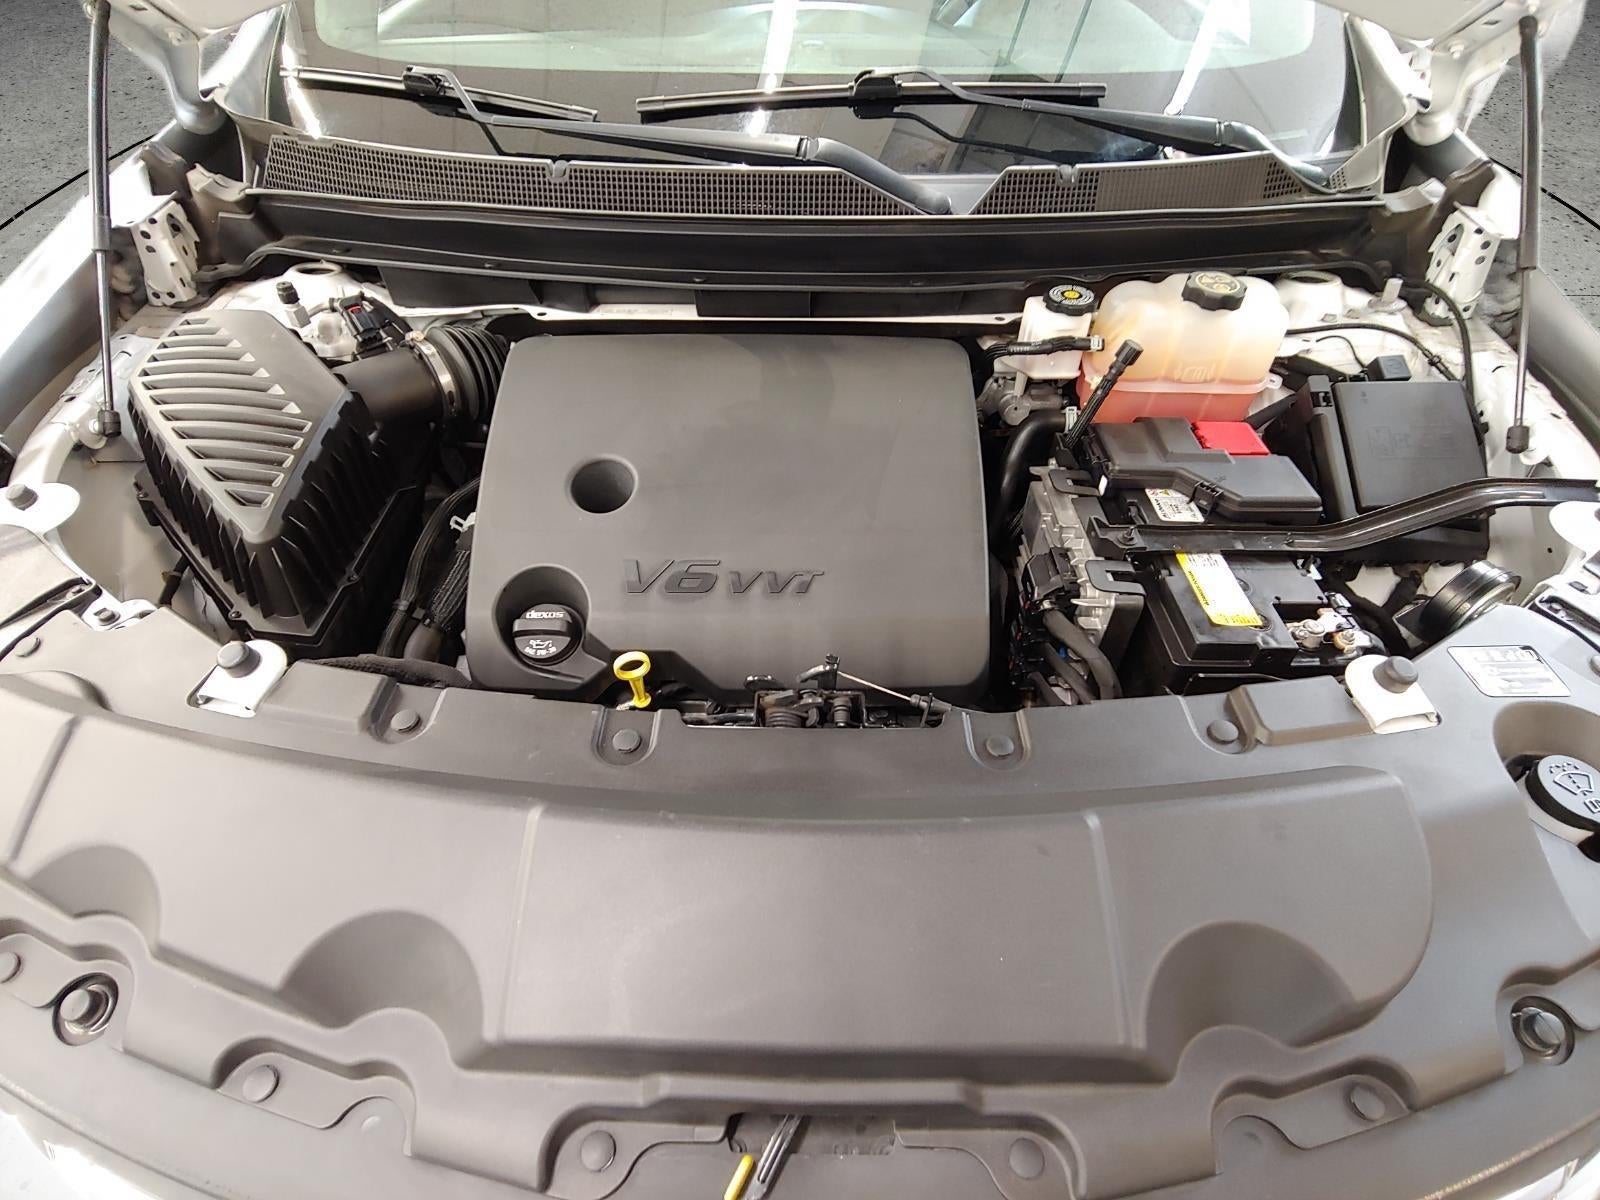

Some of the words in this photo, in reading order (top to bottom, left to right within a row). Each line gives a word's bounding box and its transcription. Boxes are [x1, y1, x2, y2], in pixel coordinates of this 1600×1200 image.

[623, 559, 721, 593] V6
[729, 570, 825, 593] VVT
[525, 609, 566, 619] dexos
